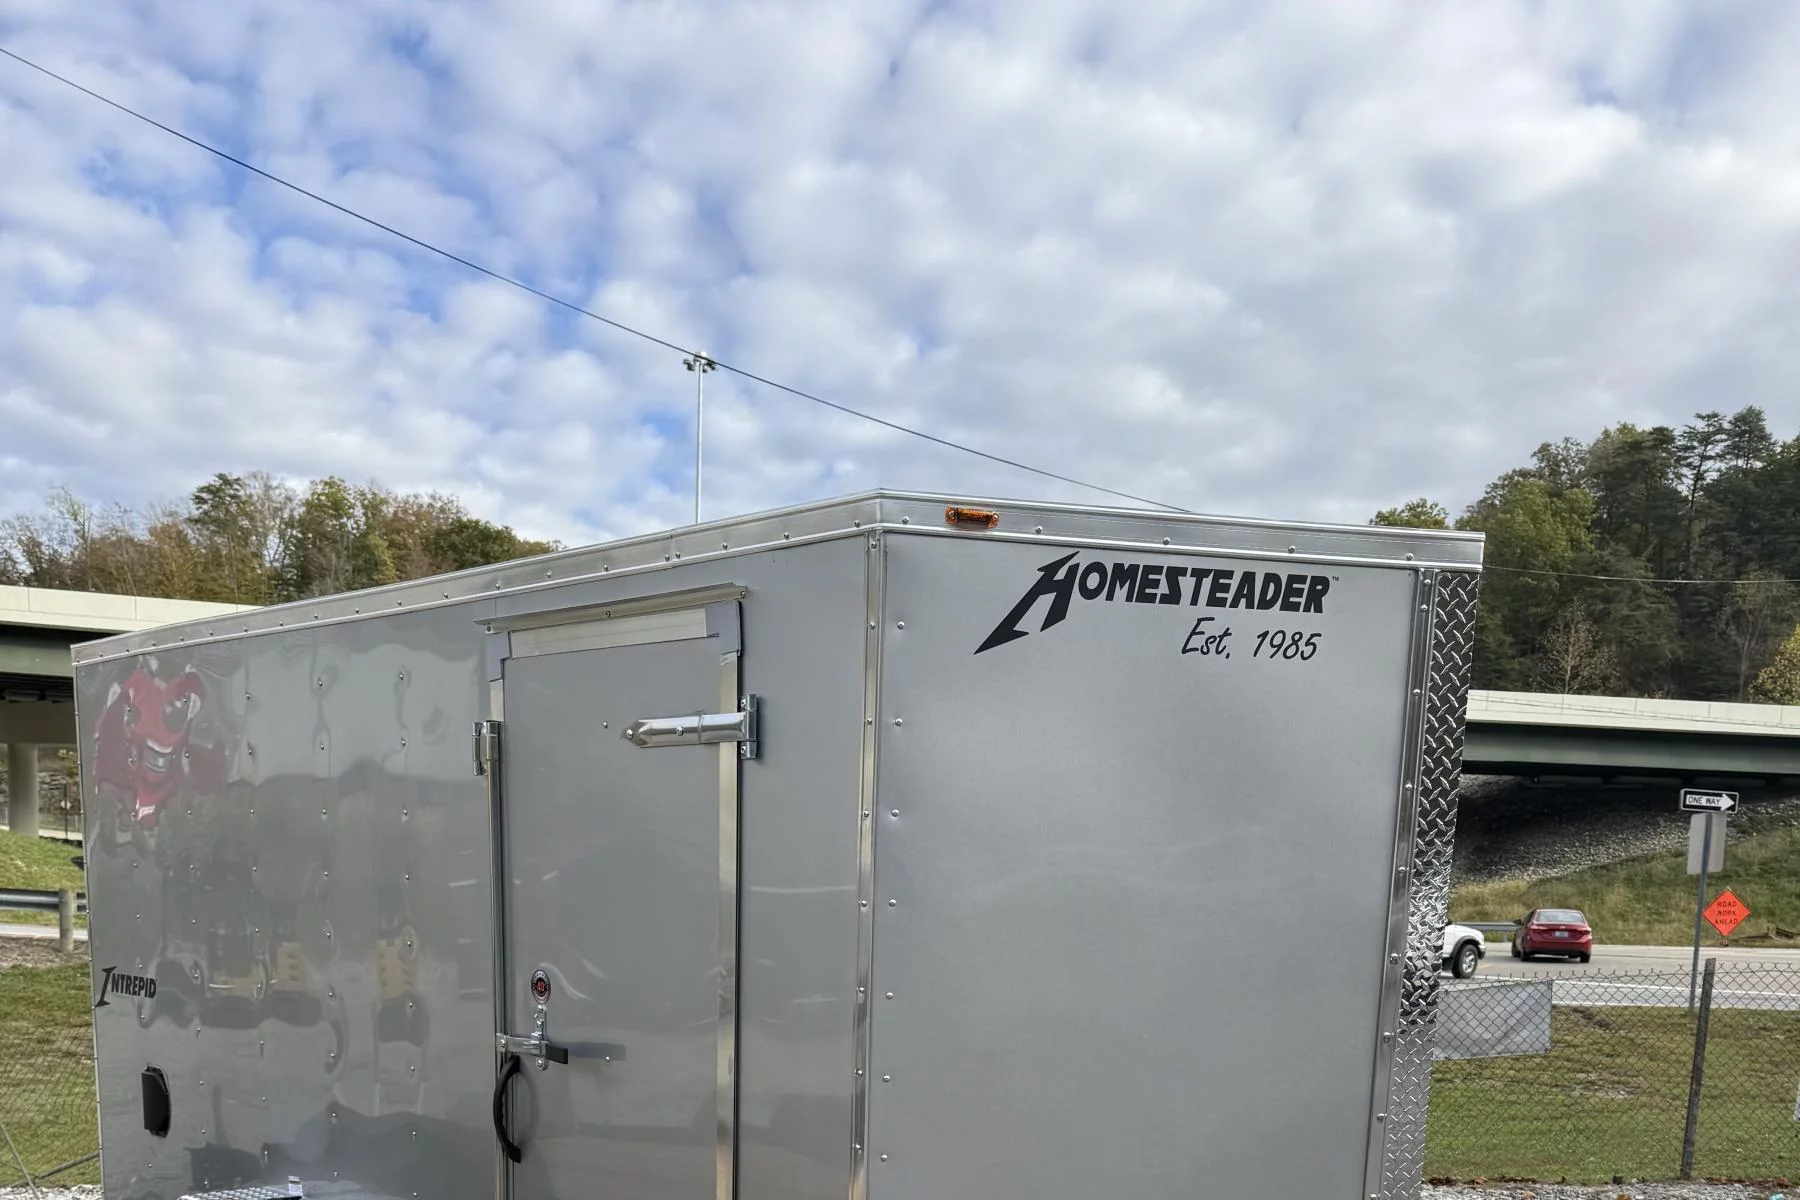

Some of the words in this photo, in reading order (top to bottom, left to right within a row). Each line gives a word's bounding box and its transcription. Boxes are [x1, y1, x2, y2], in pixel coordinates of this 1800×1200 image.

[974, 550, 1330, 655] HOMESTEADER
[1181, 616, 1233, 660] Est.
[1252, 629, 1323, 661] 1985
[1688, 796, 1704, 805] ONE
[1705, 797, 1721, 806] WAY
[95, 965, 157, 1008] INTREPID
